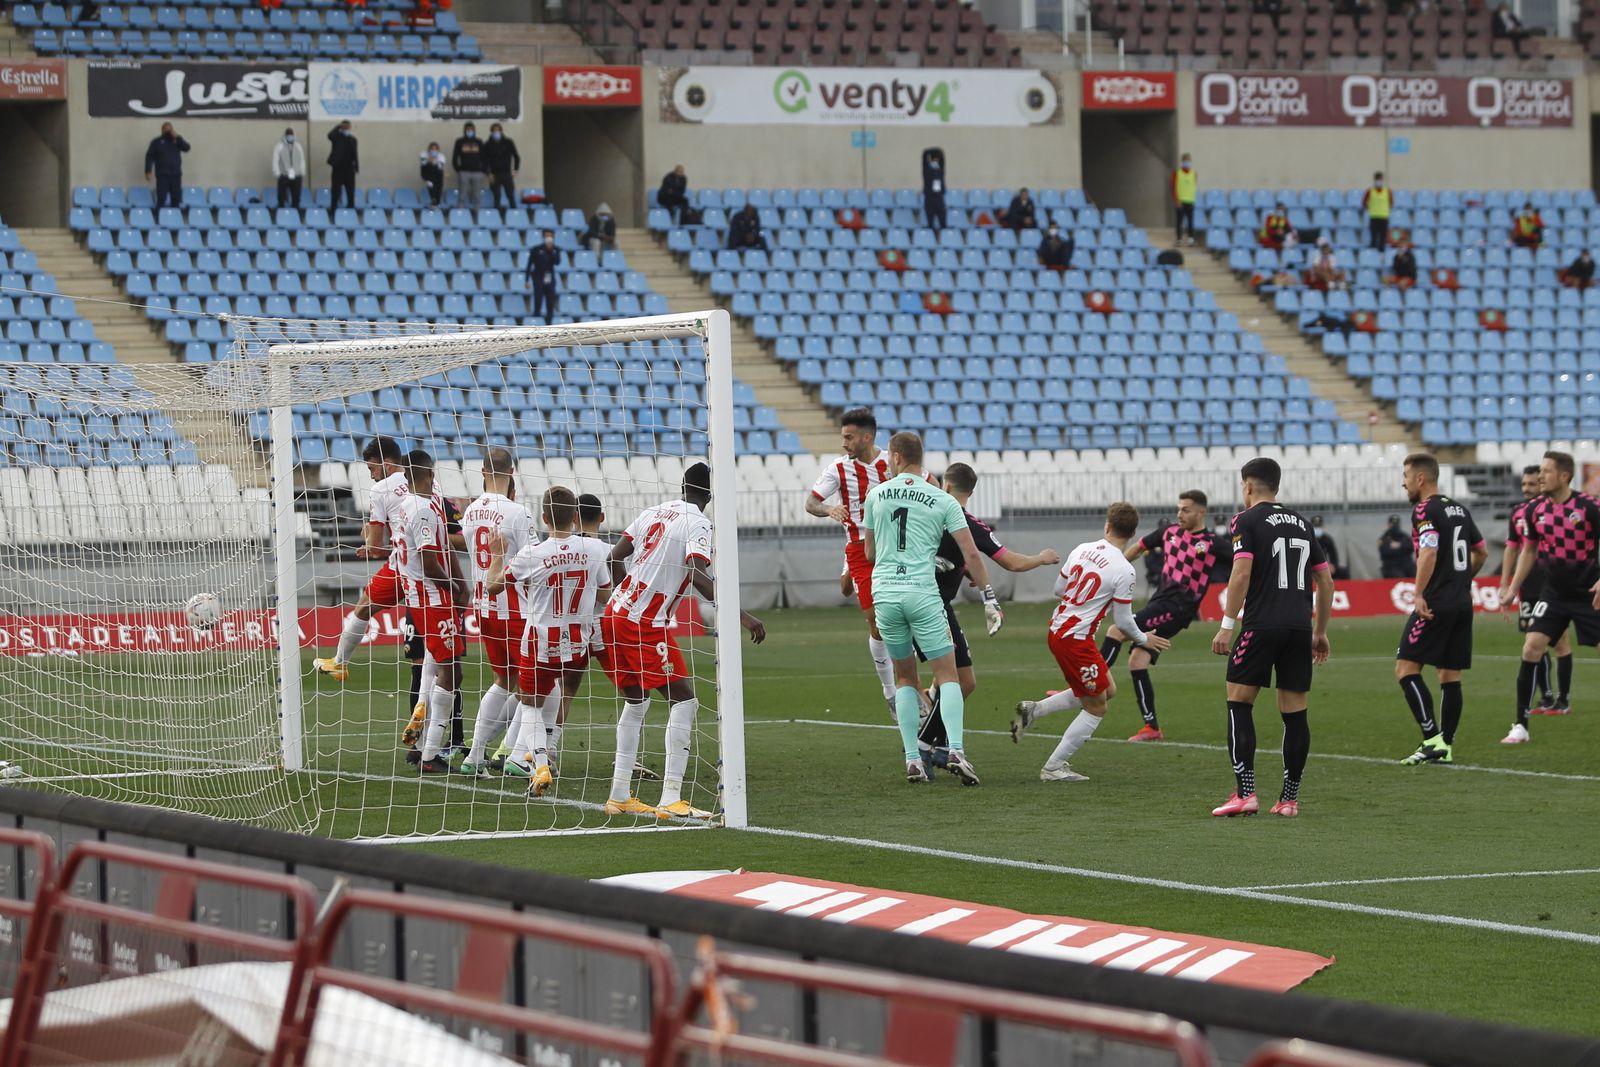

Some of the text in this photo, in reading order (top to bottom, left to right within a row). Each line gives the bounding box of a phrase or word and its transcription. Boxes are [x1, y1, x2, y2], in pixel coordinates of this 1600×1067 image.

[0, 67, 59, 85] Estrella
[1239, 77, 1299, 97] grupo
[17, 84, 43, 94] Damm
[1379, 78, 1438, 98] grupo
[1503, 80, 1562, 99] grupo
[818, 78, 955, 122] venty4
[1239, 93, 1309, 116] control
[1379, 94, 1448, 117] control
[1504, 95, 1571, 118] control
[878, 488, 938, 509] MAKARIDZE
[891, 507, 909, 552] 1
[1265, 513, 1298, 527] VICTOR
[643, 522, 666, 564] 9
[1453, 525, 1467, 571] 6
[543, 553, 588, 569] CORPAS
[1079, 551, 1109, 569] BALLIU
[1272, 537, 1310, 590] 17
[547, 570, 588, 618] 17
[1064, 564, 1102, 606] 20
[656, 642, 669, 663] 9
